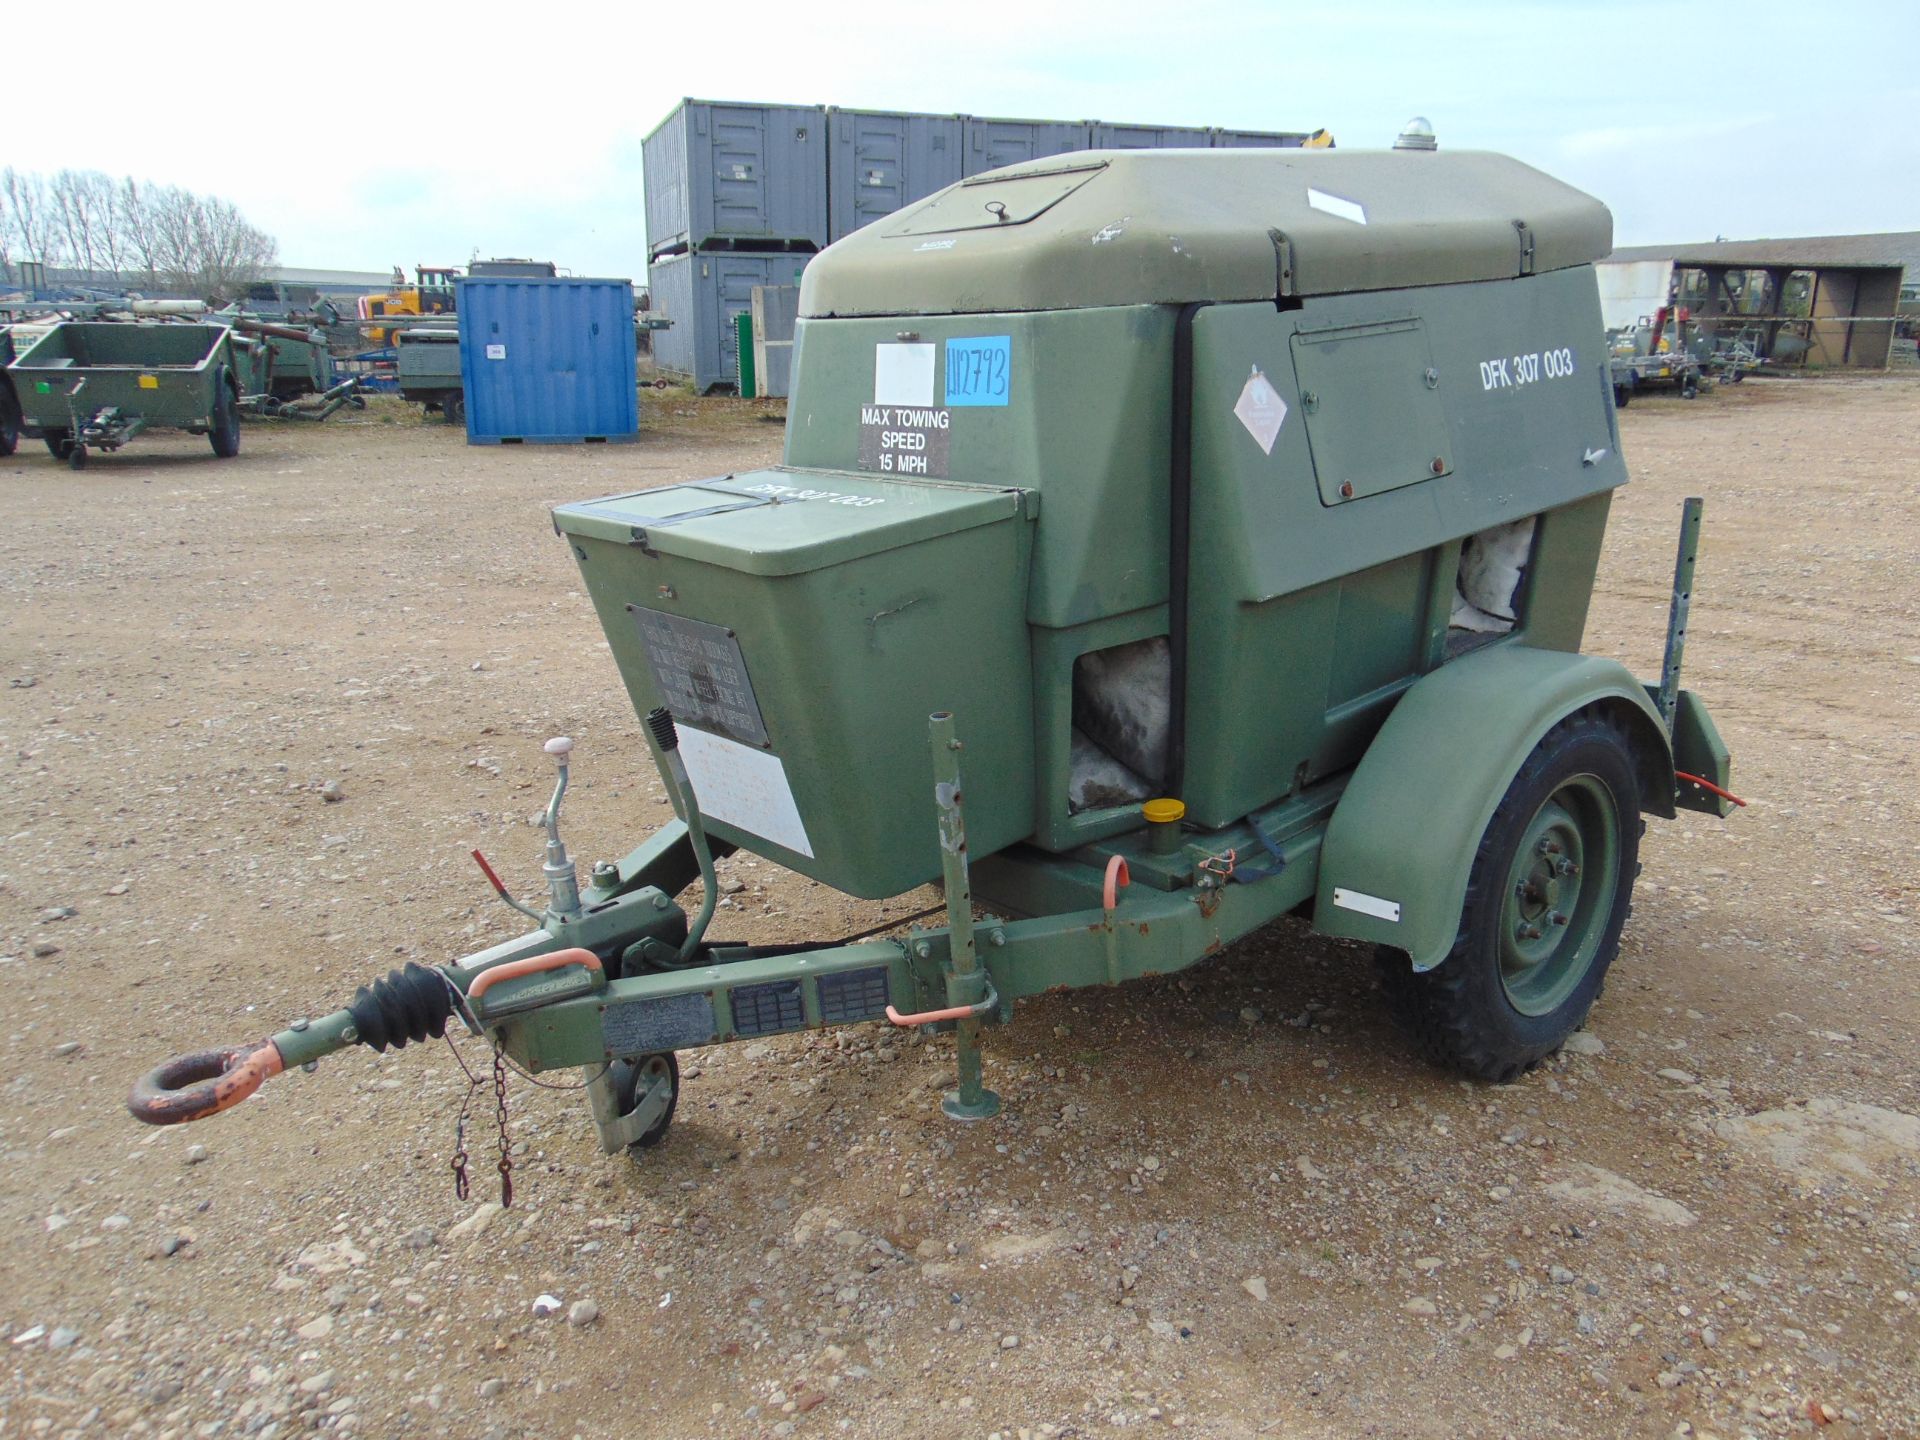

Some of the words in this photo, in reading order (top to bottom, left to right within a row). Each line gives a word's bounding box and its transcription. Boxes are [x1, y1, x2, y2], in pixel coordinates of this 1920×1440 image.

[1479, 358, 1512, 390] DFK
[1513, 353, 1539, 385] 307
[1544, 347, 1574, 379] 003
[861, 408, 890, 426] MAX
[895, 409, 949, 429] TOWING
[881, 431, 926, 450] SPEED
[879, 453, 893, 470] 15
[897, 454, 927, 473] MPH
